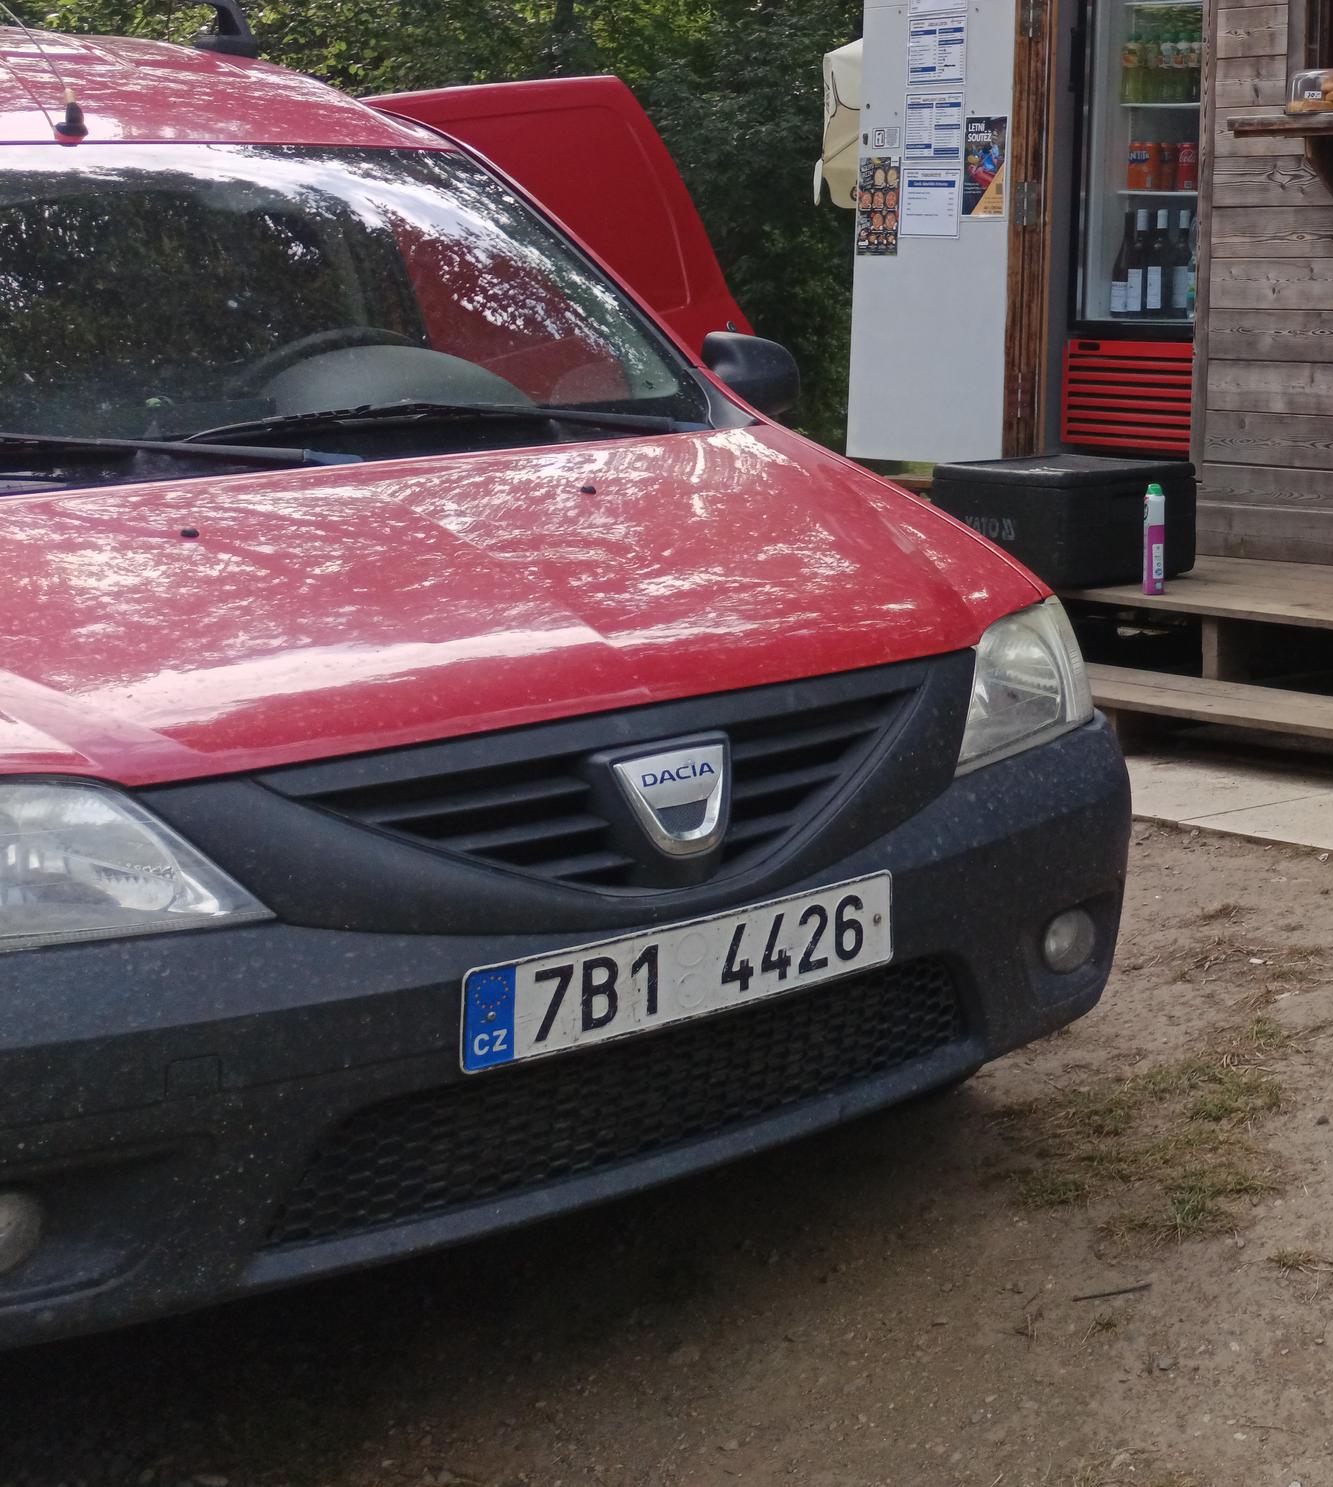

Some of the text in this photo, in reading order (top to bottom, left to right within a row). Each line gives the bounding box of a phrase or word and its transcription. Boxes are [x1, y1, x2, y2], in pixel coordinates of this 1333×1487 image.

[967, 131, 992, 142] SOUTĚŽ
[968, 121, 986, 132] LETNÍ
[641, 761, 715, 788] DACIA
[533, 894, 864, 1043] 7B1 4426
[474, 1028, 508, 1056] CZ
